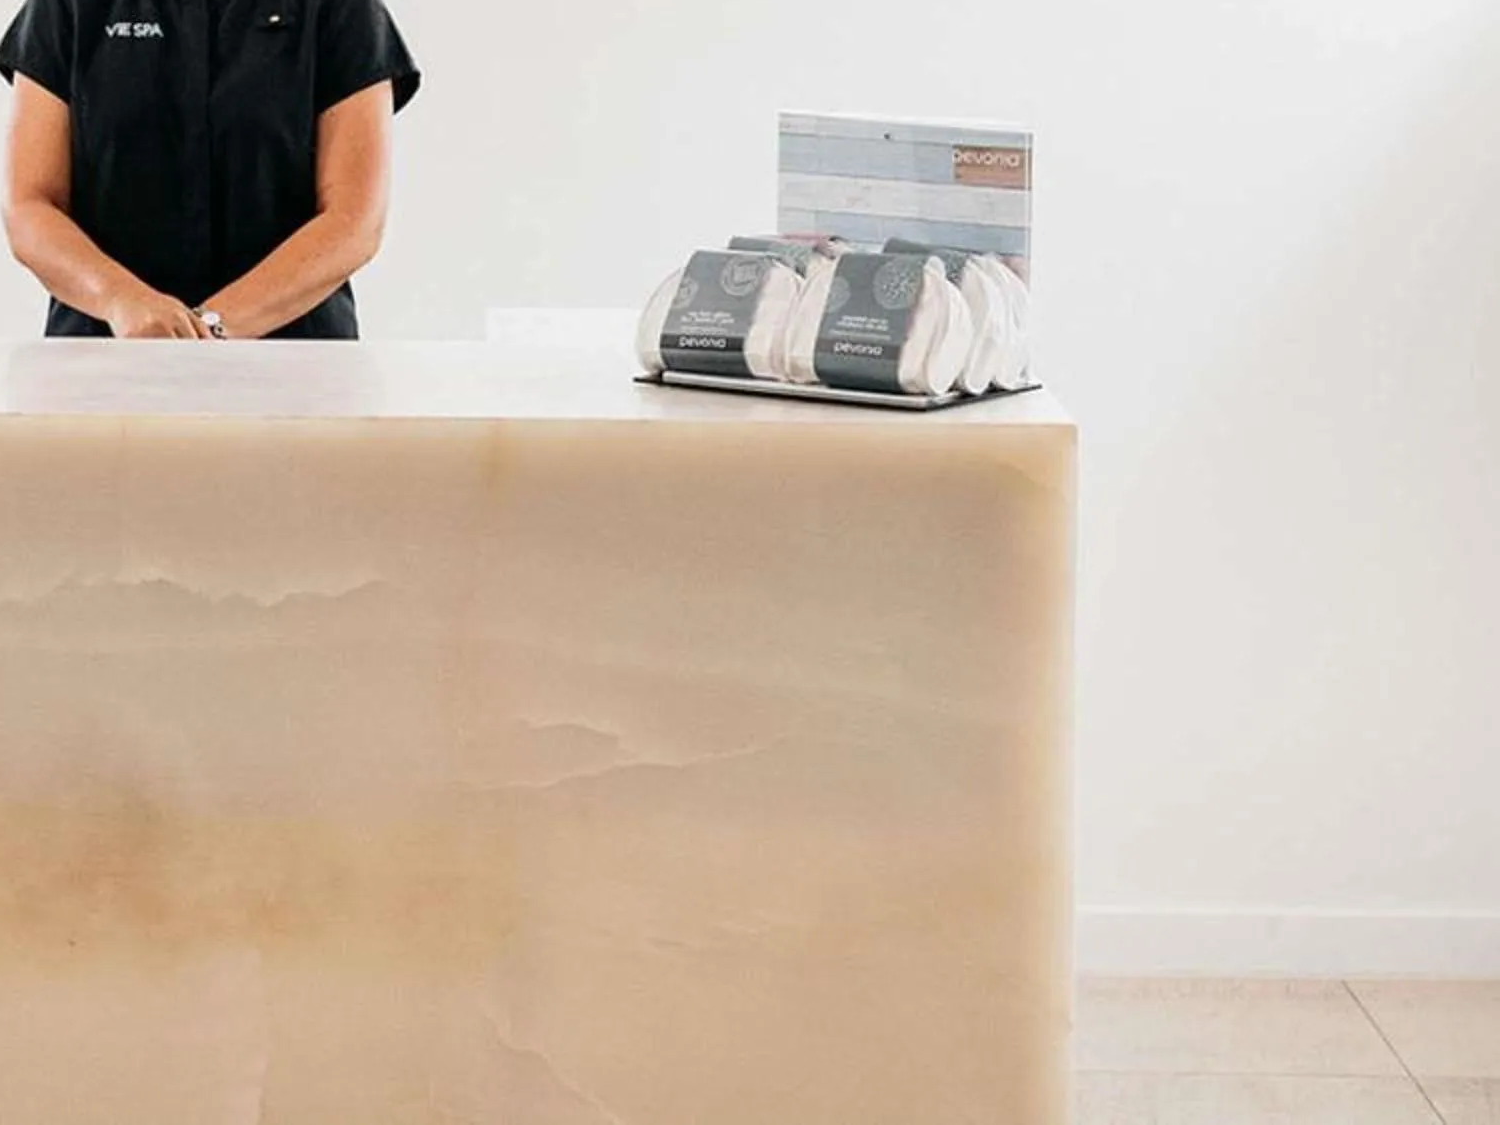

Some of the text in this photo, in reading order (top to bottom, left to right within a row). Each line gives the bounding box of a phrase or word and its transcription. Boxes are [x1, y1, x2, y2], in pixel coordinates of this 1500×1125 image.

[104, 22, 164, 38] VIE SPA
[951, 148, 1021, 168] pevonia
